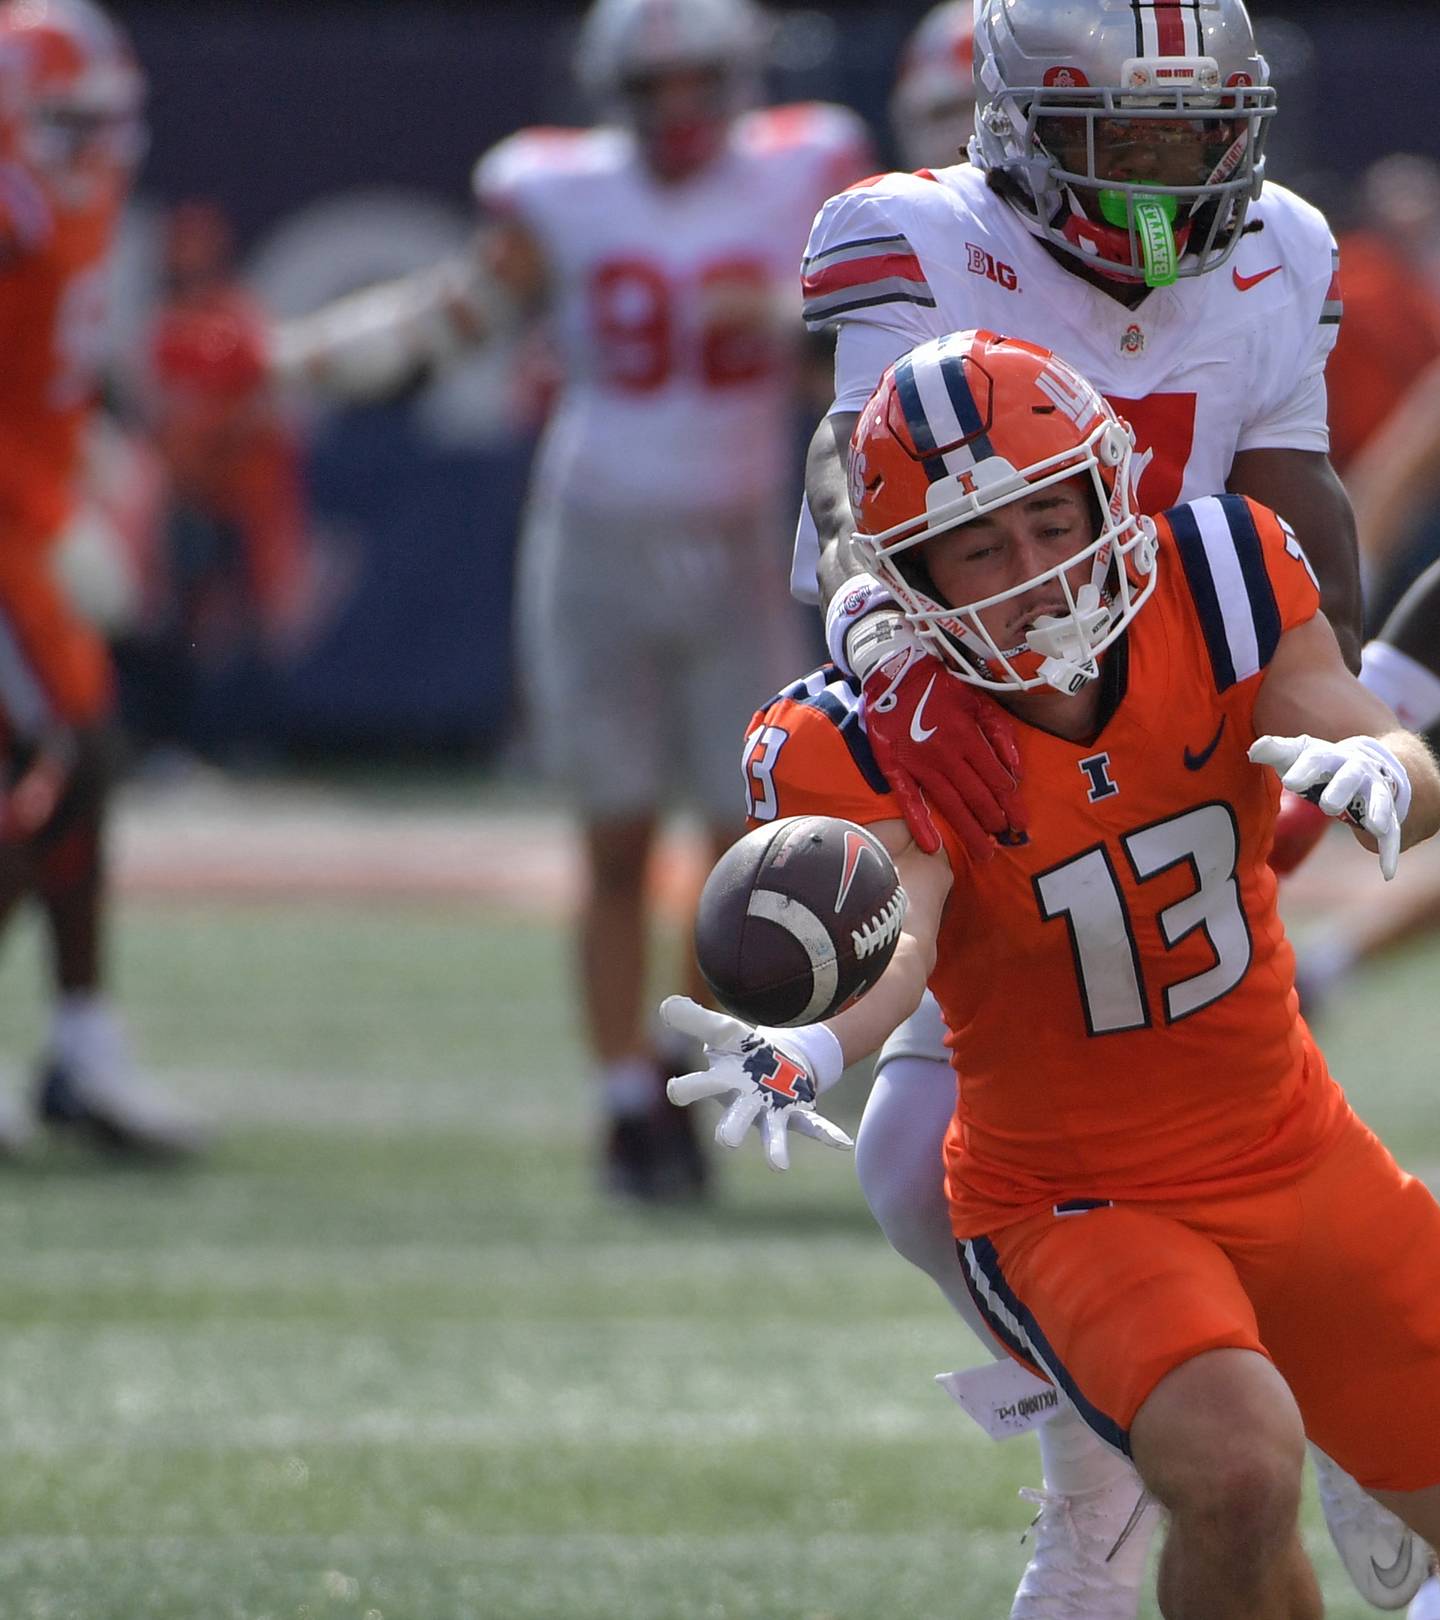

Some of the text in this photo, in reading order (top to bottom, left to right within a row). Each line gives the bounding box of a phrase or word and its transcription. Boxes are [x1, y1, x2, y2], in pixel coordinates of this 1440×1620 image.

[1173, 69, 1194, 78] STATE
[1144, 206, 1169, 275] BATTLE
[741, 724, 789, 822] 13
[1078, 752, 1119, 803] I
[1031, 800, 1253, 1038] 13
[759, 1050, 807, 1099] I
